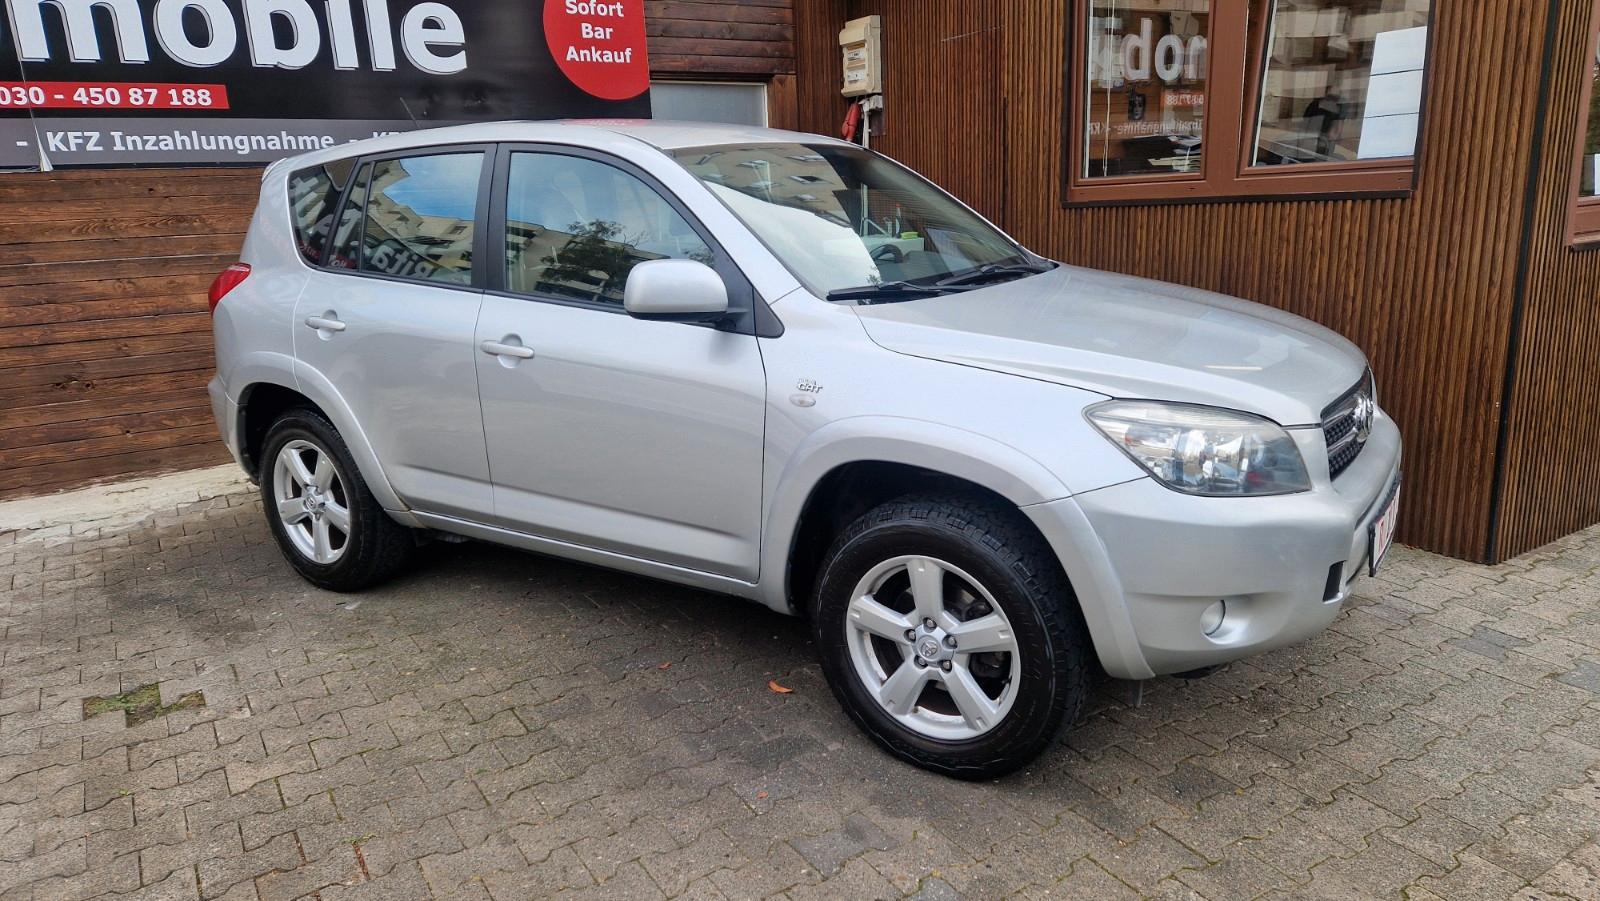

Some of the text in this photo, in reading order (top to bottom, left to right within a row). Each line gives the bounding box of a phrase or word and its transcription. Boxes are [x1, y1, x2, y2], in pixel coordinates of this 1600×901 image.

[565, 0, 624, 17] Sofort
[3, 0, 468, 75] mobile
[581, 22, 613, 39] Bar
[566, 45, 632, 63] Ankauf
[73, 87, 121, 105] 450
[128, 88, 158, 105] 87
[168, 88, 212, 106] 188
[46, 131, 101, 152] KFZ
[110, 130, 335, 155] Inzahlungnahme
